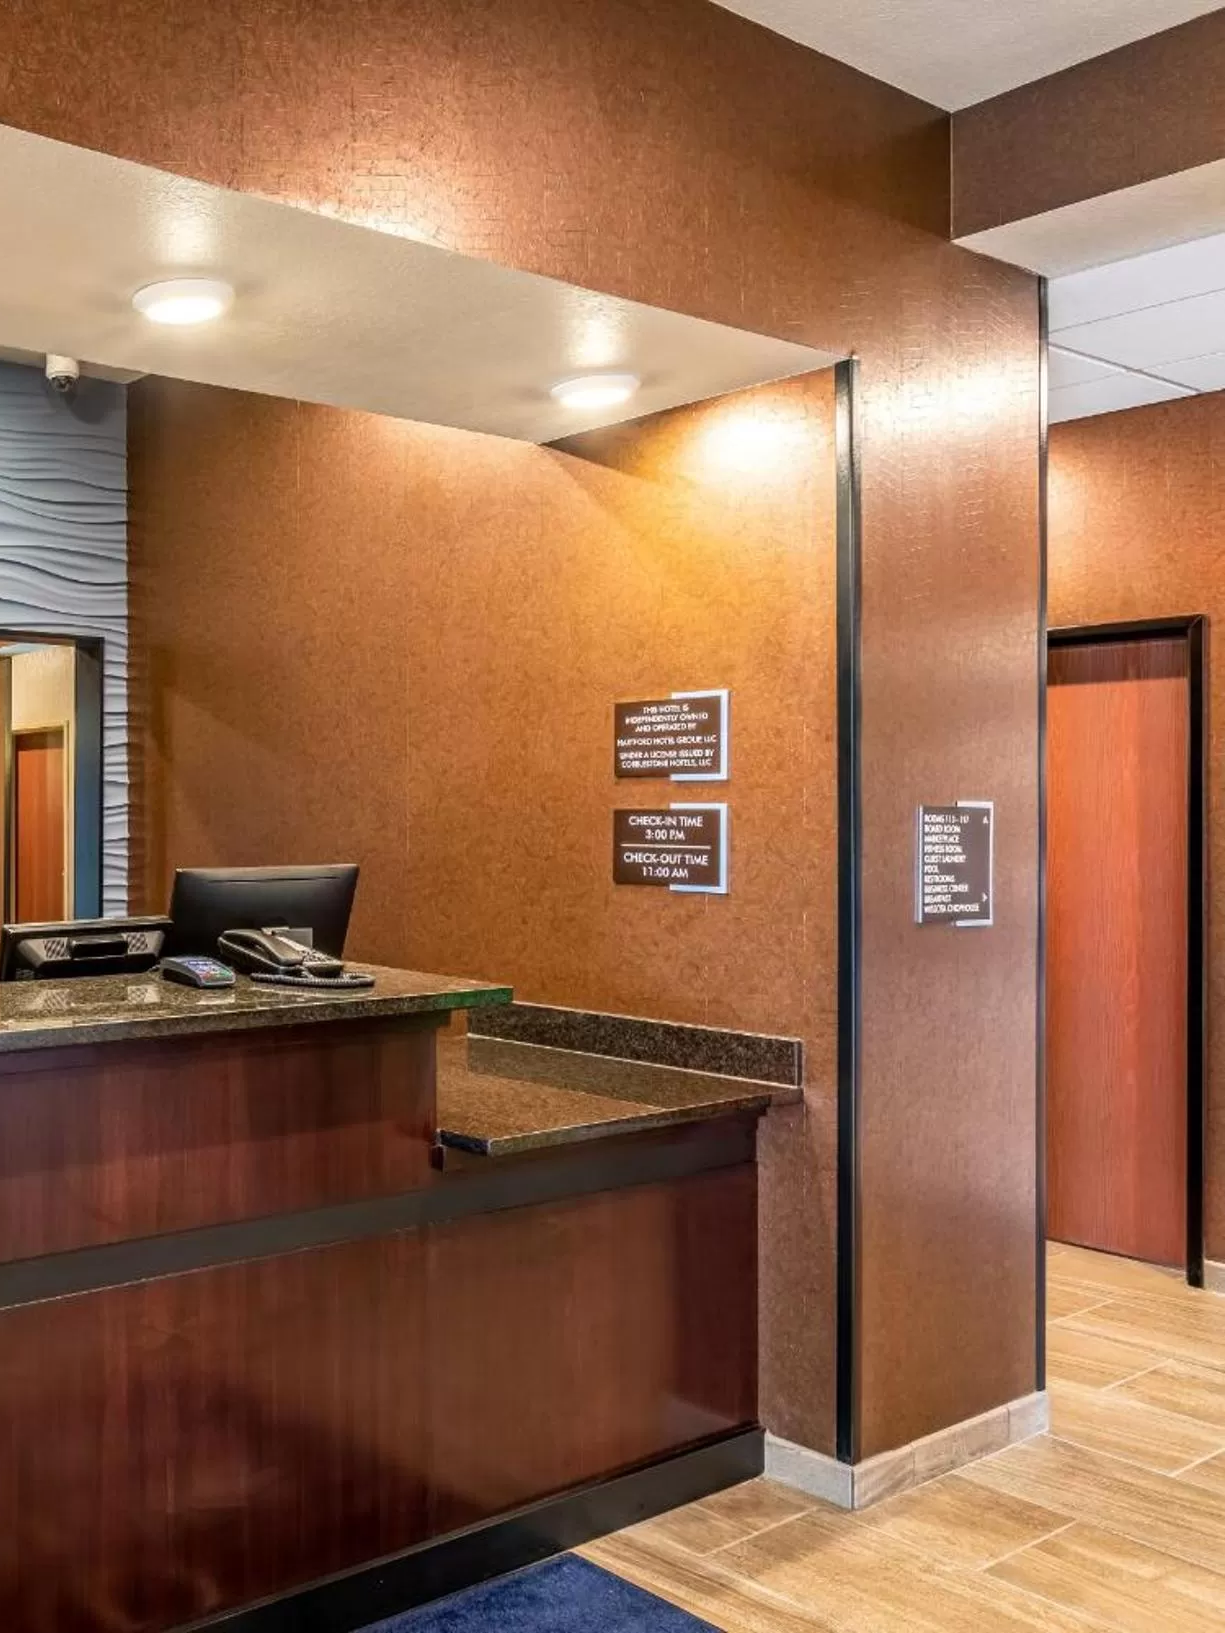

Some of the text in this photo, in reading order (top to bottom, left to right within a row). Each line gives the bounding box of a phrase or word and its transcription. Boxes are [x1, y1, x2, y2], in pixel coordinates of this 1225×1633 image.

[658, 705, 681, 713] HOTEL
[625, 714, 678, 724] INDEPENDENTLY
[652, 724, 686, 732] OPERATED
[652, 737, 675, 745] HOTEL
[705, 749, 714, 757] BY
[622, 760, 668, 768] COBBLESTONE
[628, 816, 703, 827] CHECK-IN TIME
[924, 825, 961, 833] BOARD ROOM
[645, 829, 685, 840] 3:00 PM
[924, 835, 960, 843] MARKETPLACE
[924, 845, 963, 853] FITNESS ROOM
[623, 852, 709, 865] CHECK-OUT TIME
[924, 855, 942, 863] GUEST
[642, 866, 688, 878] 11:00 AM
[924, 865, 939, 873] POOL
[924, 875, 955, 883] RESTROOMS
[924, 884, 968, 893] BUSINESS CENTER
[924, 895, 951, 903] BREAKFAST
